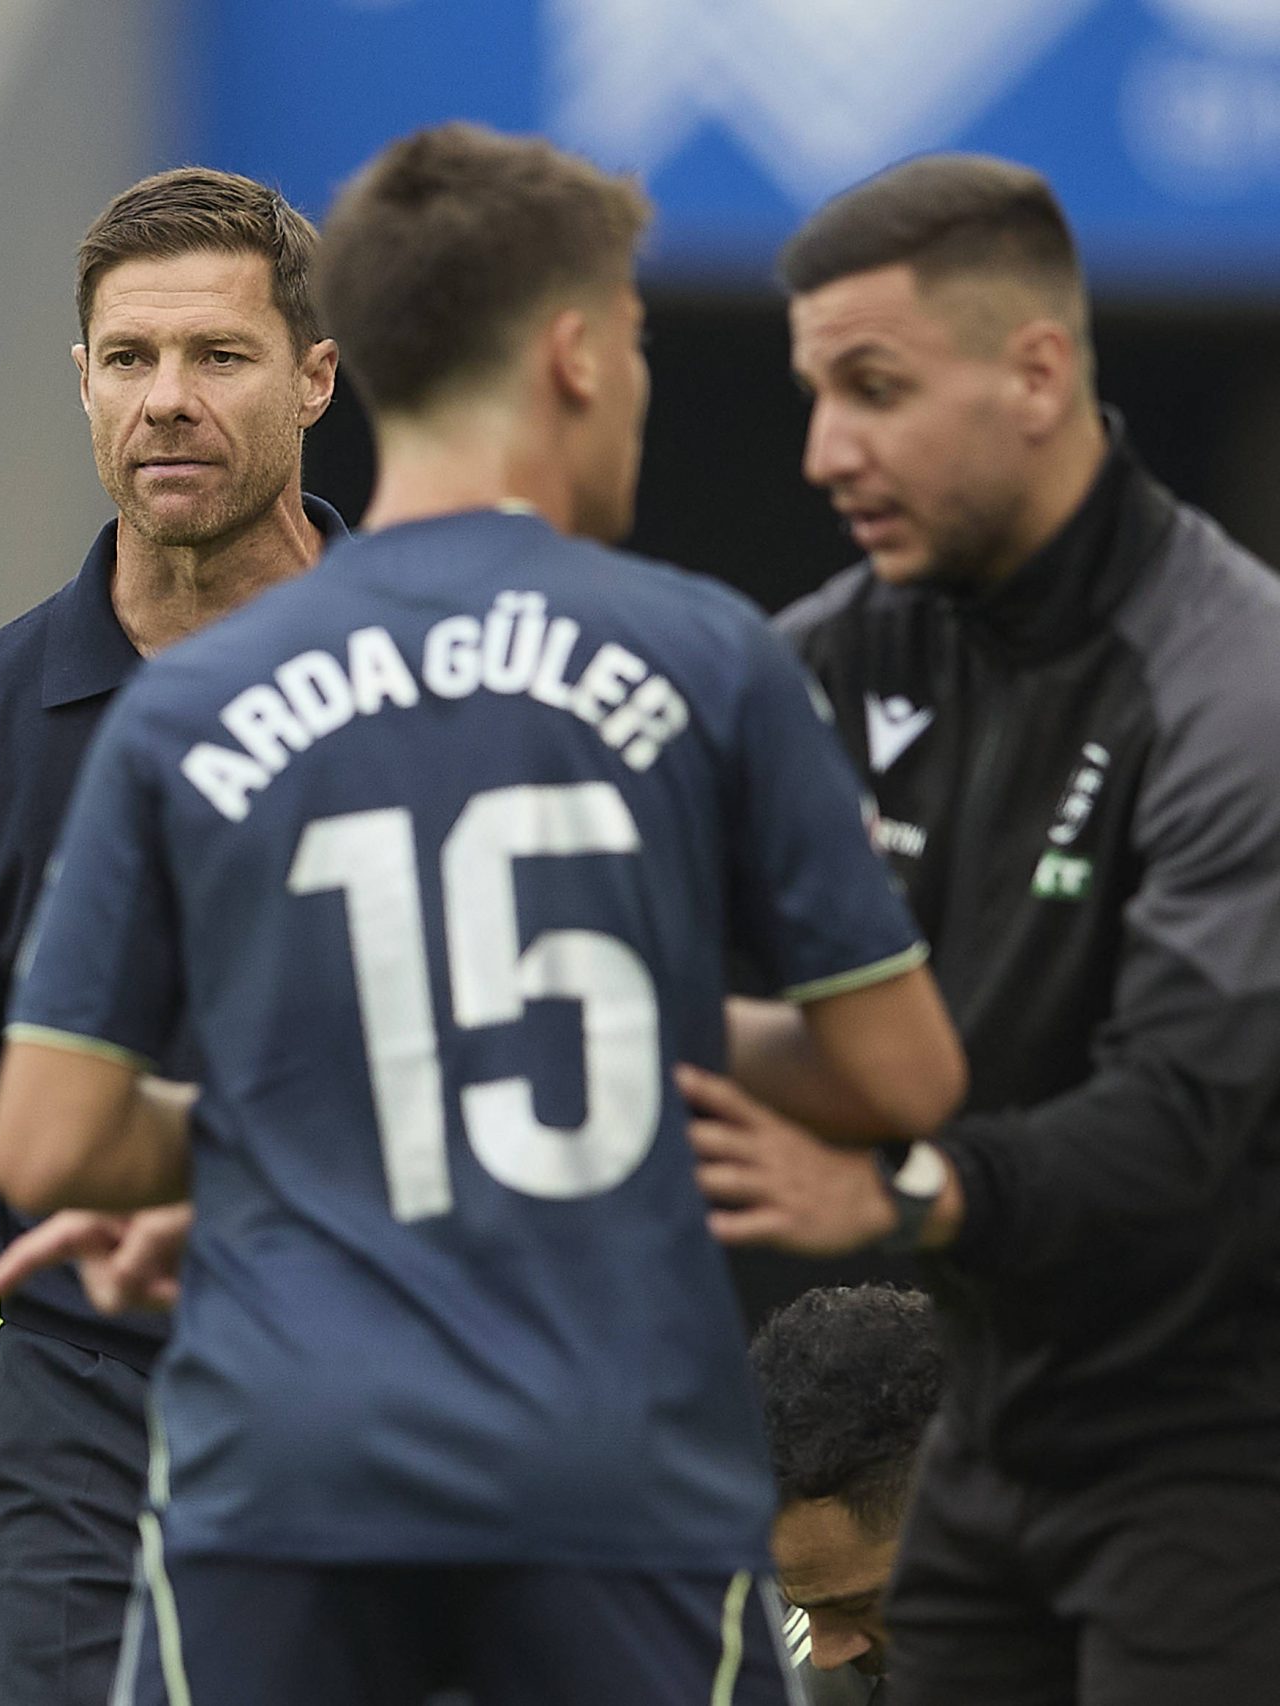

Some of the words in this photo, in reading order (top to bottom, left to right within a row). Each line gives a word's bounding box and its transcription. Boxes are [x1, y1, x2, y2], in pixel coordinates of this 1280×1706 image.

[180, 625, 419, 821] ARDA
[422, 589, 687, 771] GÜLER
[288, 780, 662, 1223] 15
